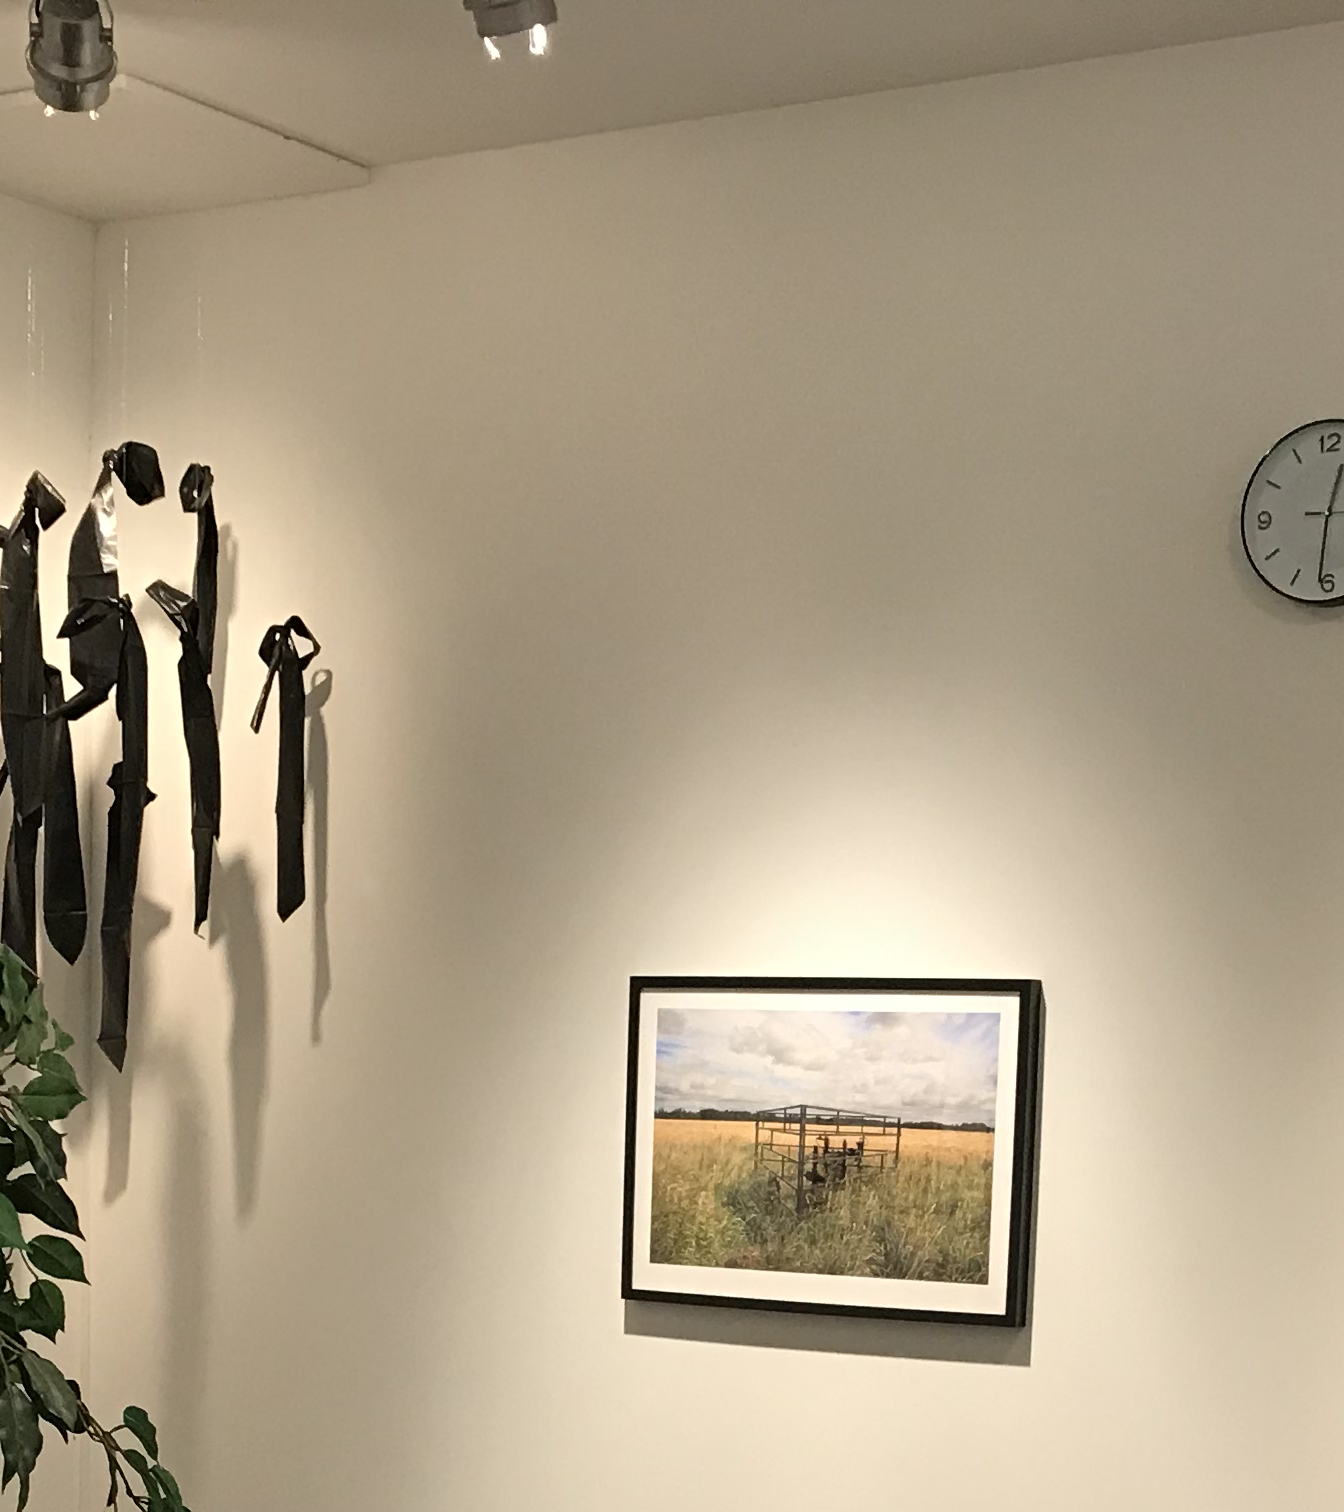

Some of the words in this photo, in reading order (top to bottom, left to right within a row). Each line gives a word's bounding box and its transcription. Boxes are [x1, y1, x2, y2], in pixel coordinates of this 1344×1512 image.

[1318, 432, 1342, 453] 12
[1257, 510, 1273, 530] 9
[1319, 573, 1336, 593] 6
